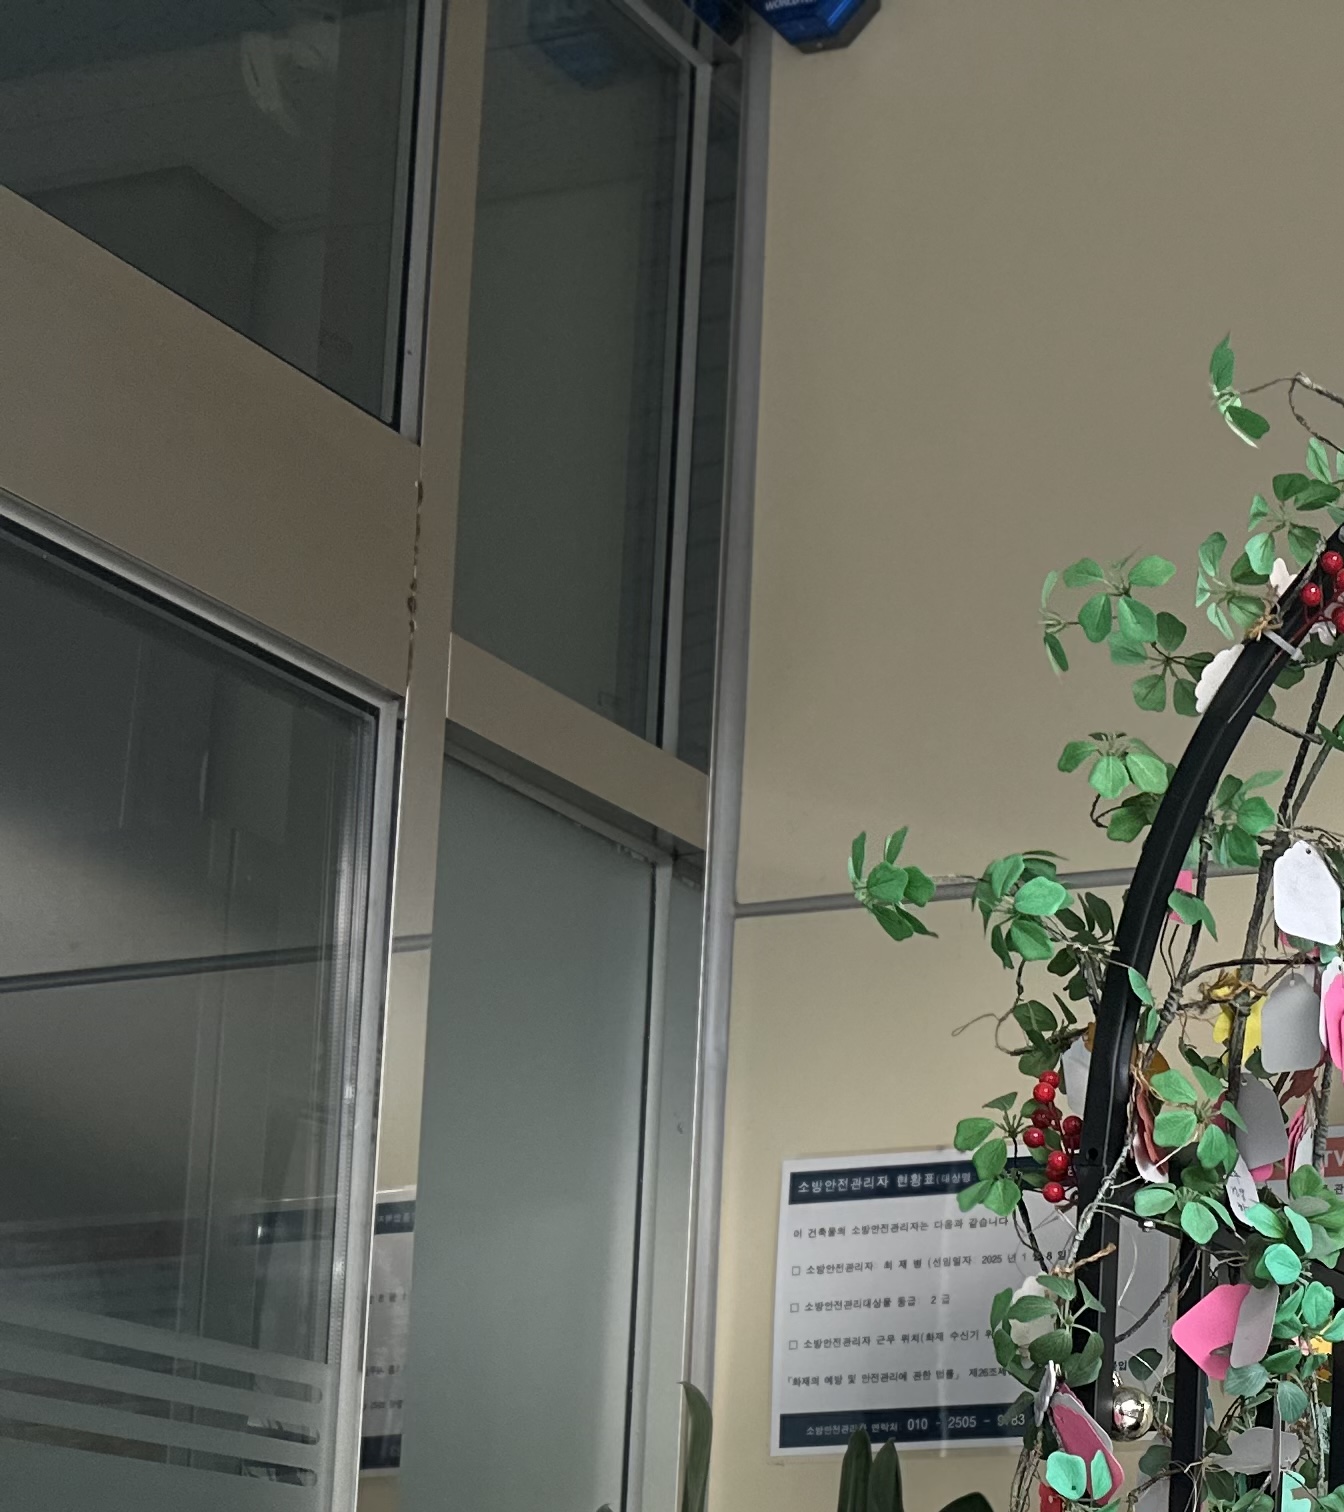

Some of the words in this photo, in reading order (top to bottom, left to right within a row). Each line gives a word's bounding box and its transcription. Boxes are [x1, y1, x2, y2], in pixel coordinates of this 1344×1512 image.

[797, 1174, 889, 1194] 소방안전관리자
[793, 1229, 803, 1239] 이
[851, 1221, 929, 1236] 소방안전관리자는
[934, 1219, 963, 1231] 다음과
[968, 1215, 1009, 1230] 같습니다
[805, 1261, 874, 1276] 소방안전관리자
[981, 1254, 1003, 1265] 2025
[1007, 1253, 1017, 1264] 년
[1046, 1250, 1053, 1261] 8
[804, 1297, 892, 1312] 소방안전관리대상물
[930, 1295, 938, 1305] 2
[941, 1293, 951, 1305] 급
[803, 1335, 871, 1349] 소방안전관리자
[876, 1334, 896, 1346] 근무
[949, 1328, 980, 1342] 수신기
[847, 1373, 857, 1385] 및
[912, 1369, 932, 1382] 관한
[907, 1417, 929, 1432] 010
[947, 1415, 977, 1429] 2505
[997, 1413, 1026, 1427] 983
